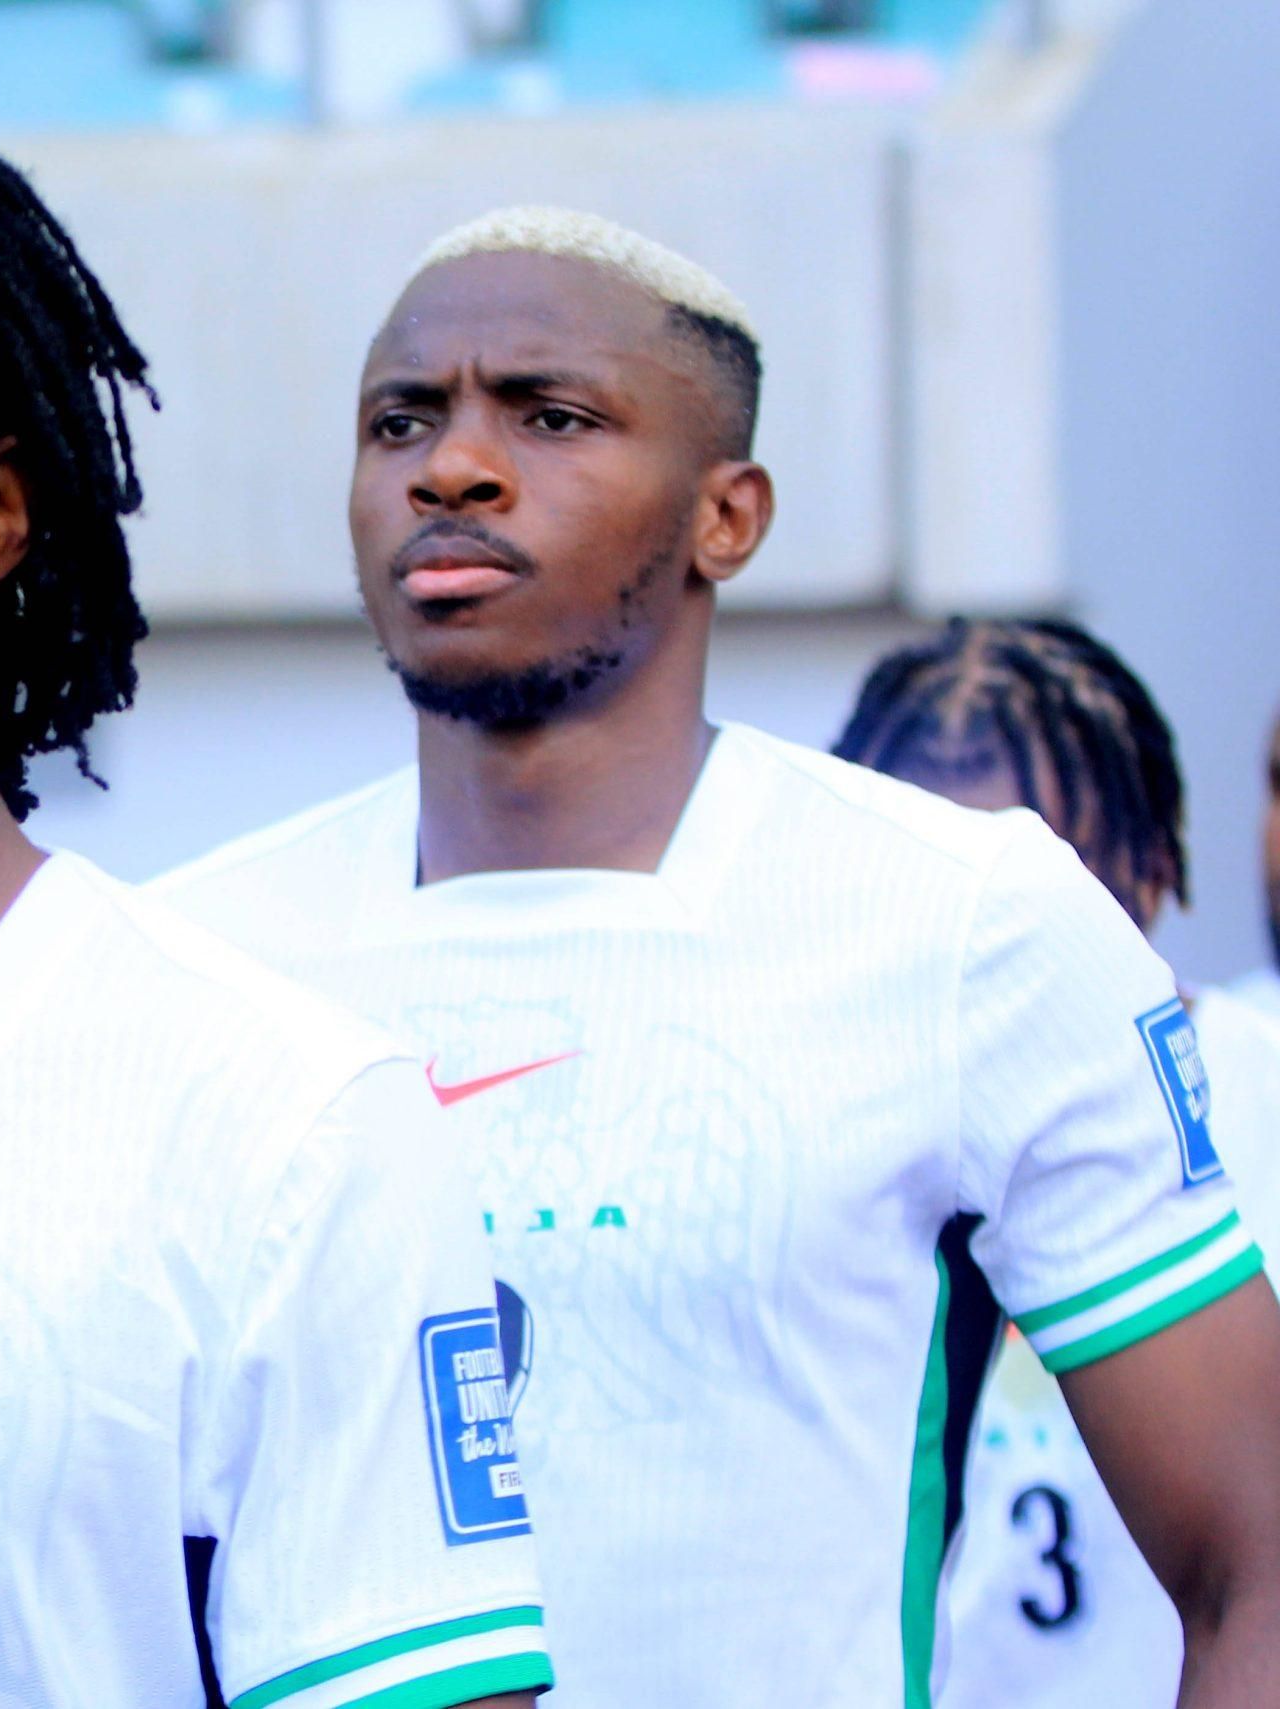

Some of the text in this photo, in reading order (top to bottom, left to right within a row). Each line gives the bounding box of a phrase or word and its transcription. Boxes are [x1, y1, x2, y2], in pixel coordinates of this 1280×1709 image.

[482, 1206, 628, 1235] IJA
[452, 1347, 505, 1382] FOOTB
[457, 1378, 510, 1424] UNIT
[499, 1470, 522, 1489] FIF
[1011, 1487, 1081, 1628] 3
